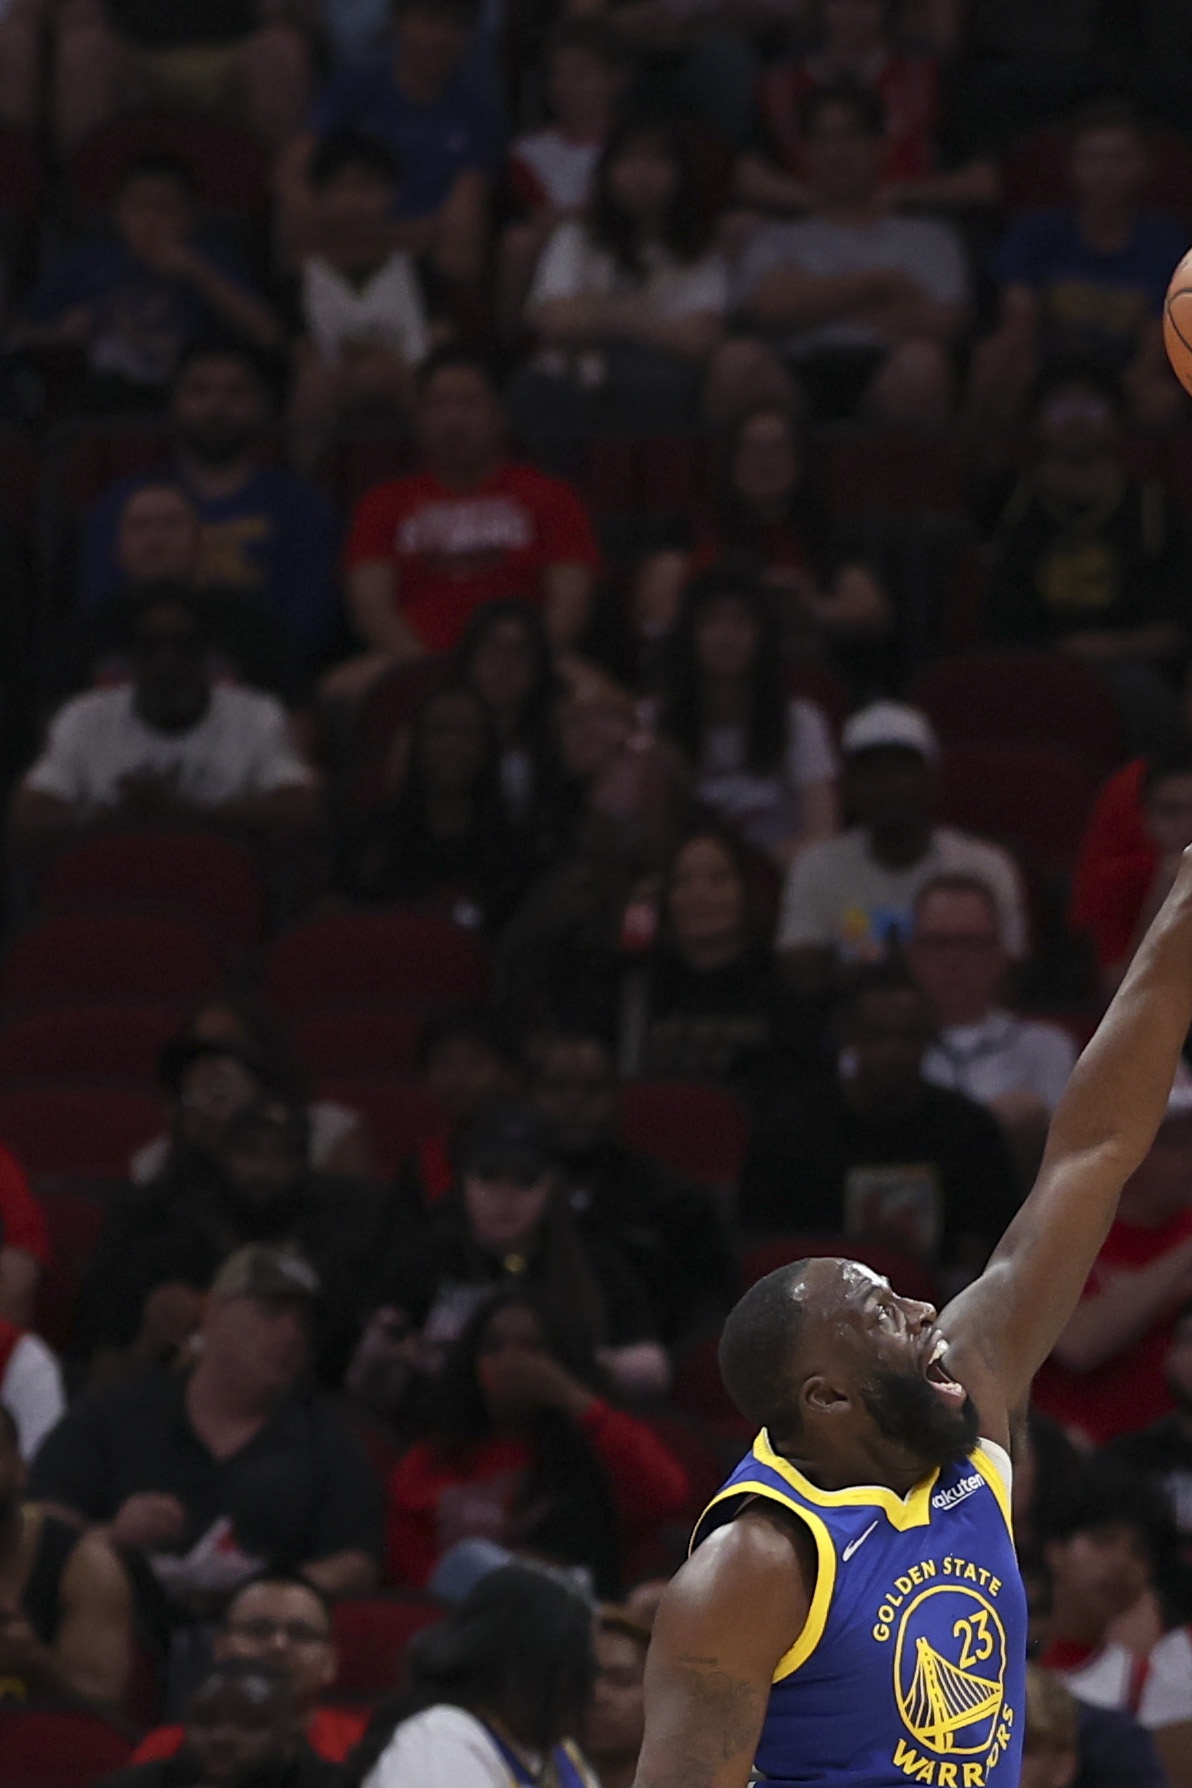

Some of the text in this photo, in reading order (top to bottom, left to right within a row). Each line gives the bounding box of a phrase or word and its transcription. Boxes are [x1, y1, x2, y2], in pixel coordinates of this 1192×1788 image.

[873, 1557, 1002, 1642] GOLDEN STATE
[953, 1609, 995, 1670] 23
[892, 1704, 1014, 1788] WARRORS
